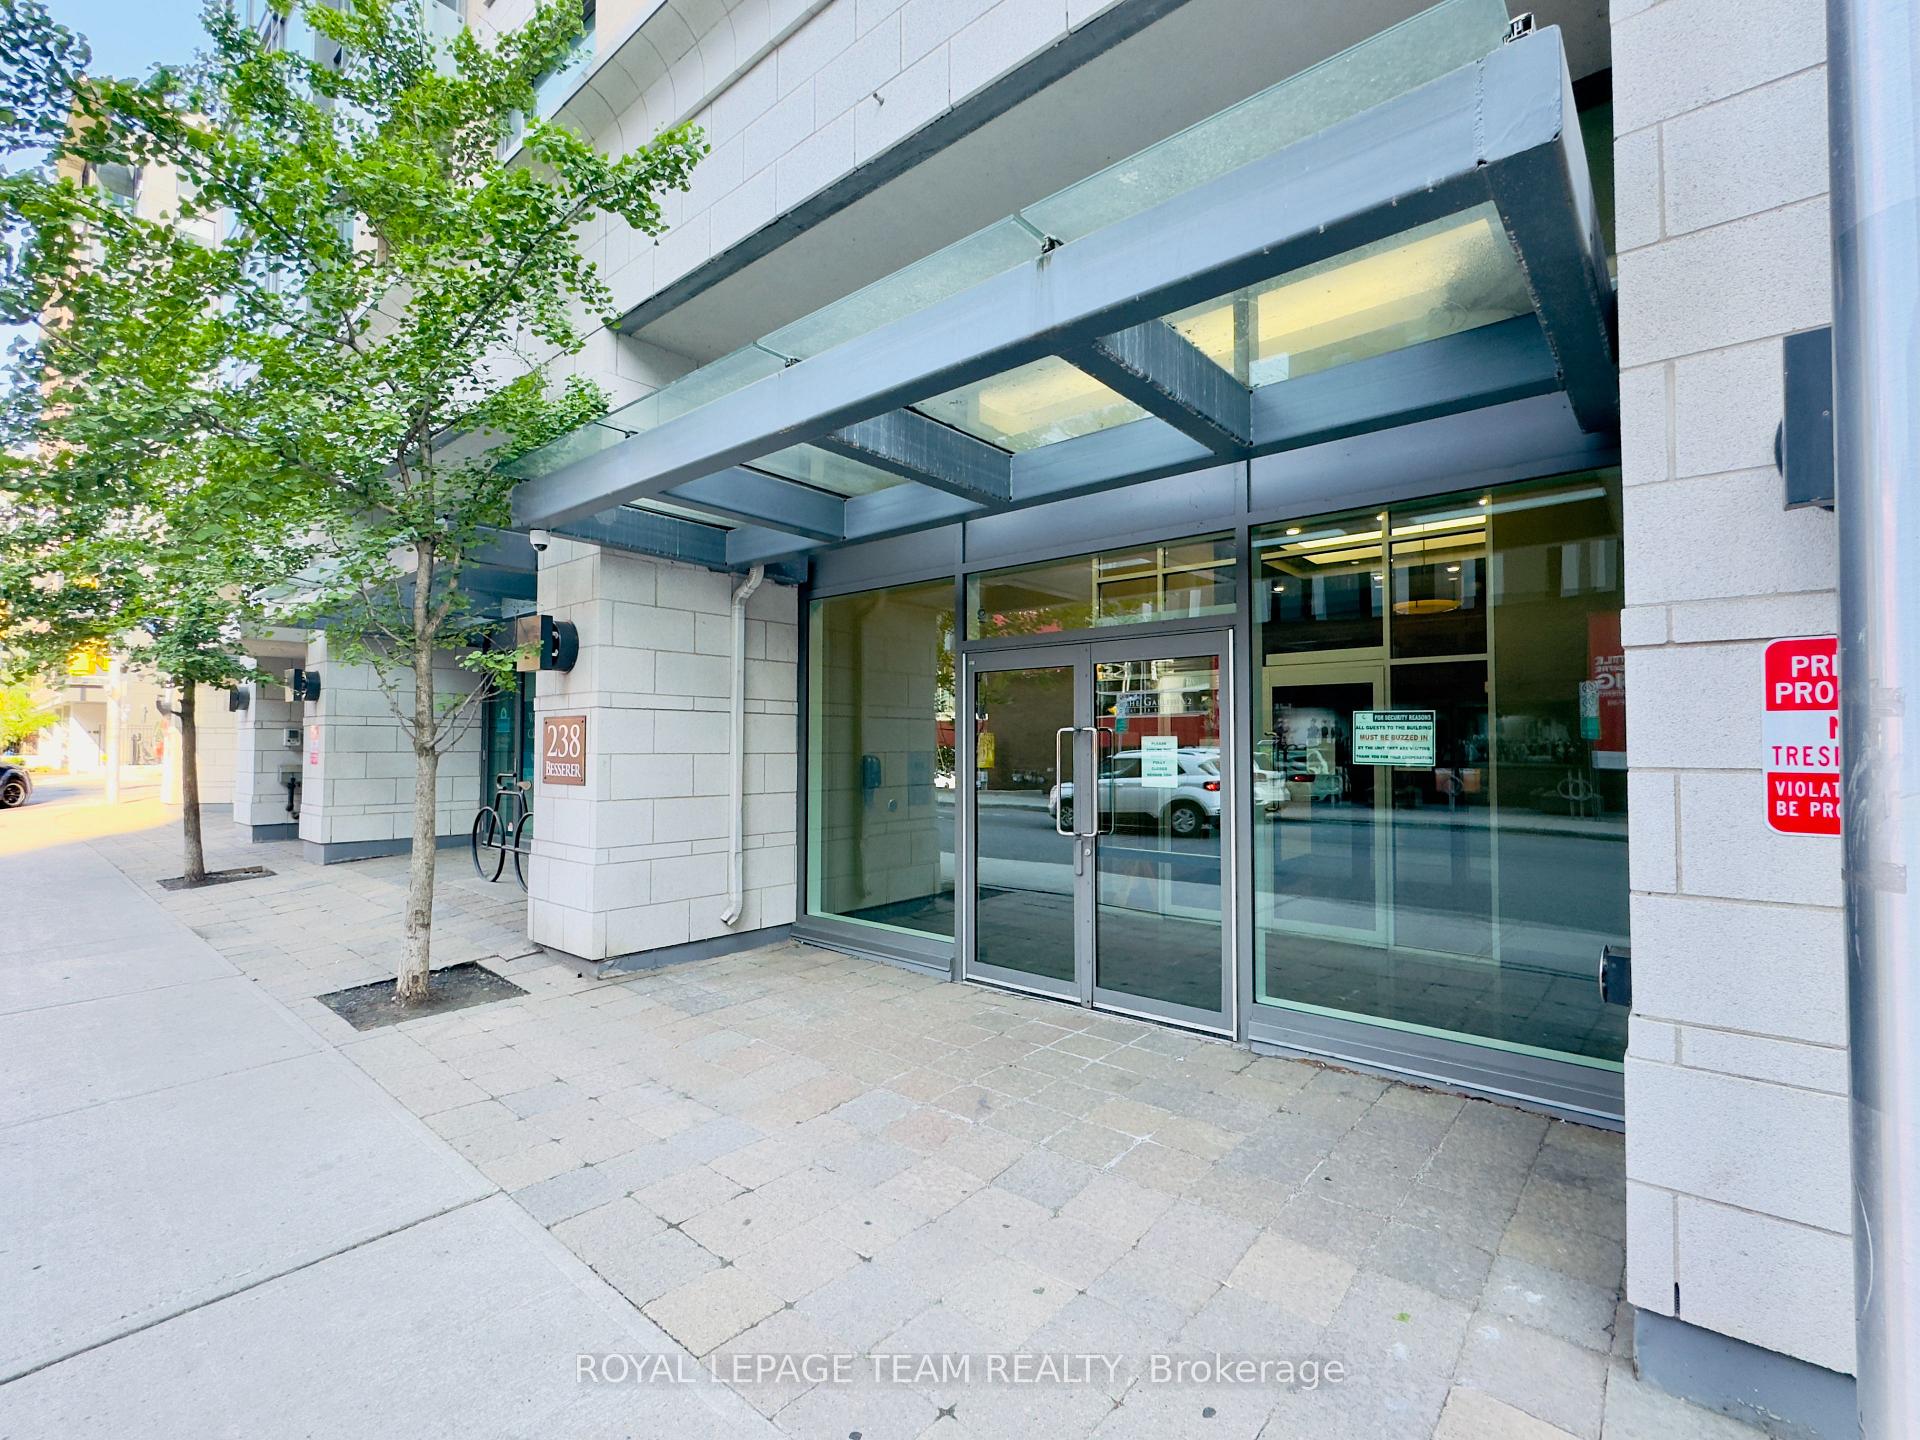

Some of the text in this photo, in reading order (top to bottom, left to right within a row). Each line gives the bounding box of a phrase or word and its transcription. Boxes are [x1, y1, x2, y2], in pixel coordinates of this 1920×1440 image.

[1775, 681, 1834, 704] PRO
[547, 724, 580, 758] 238
[545, 761, 581, 777] BESSERER
[1776, 800, 1799, 816] BE
